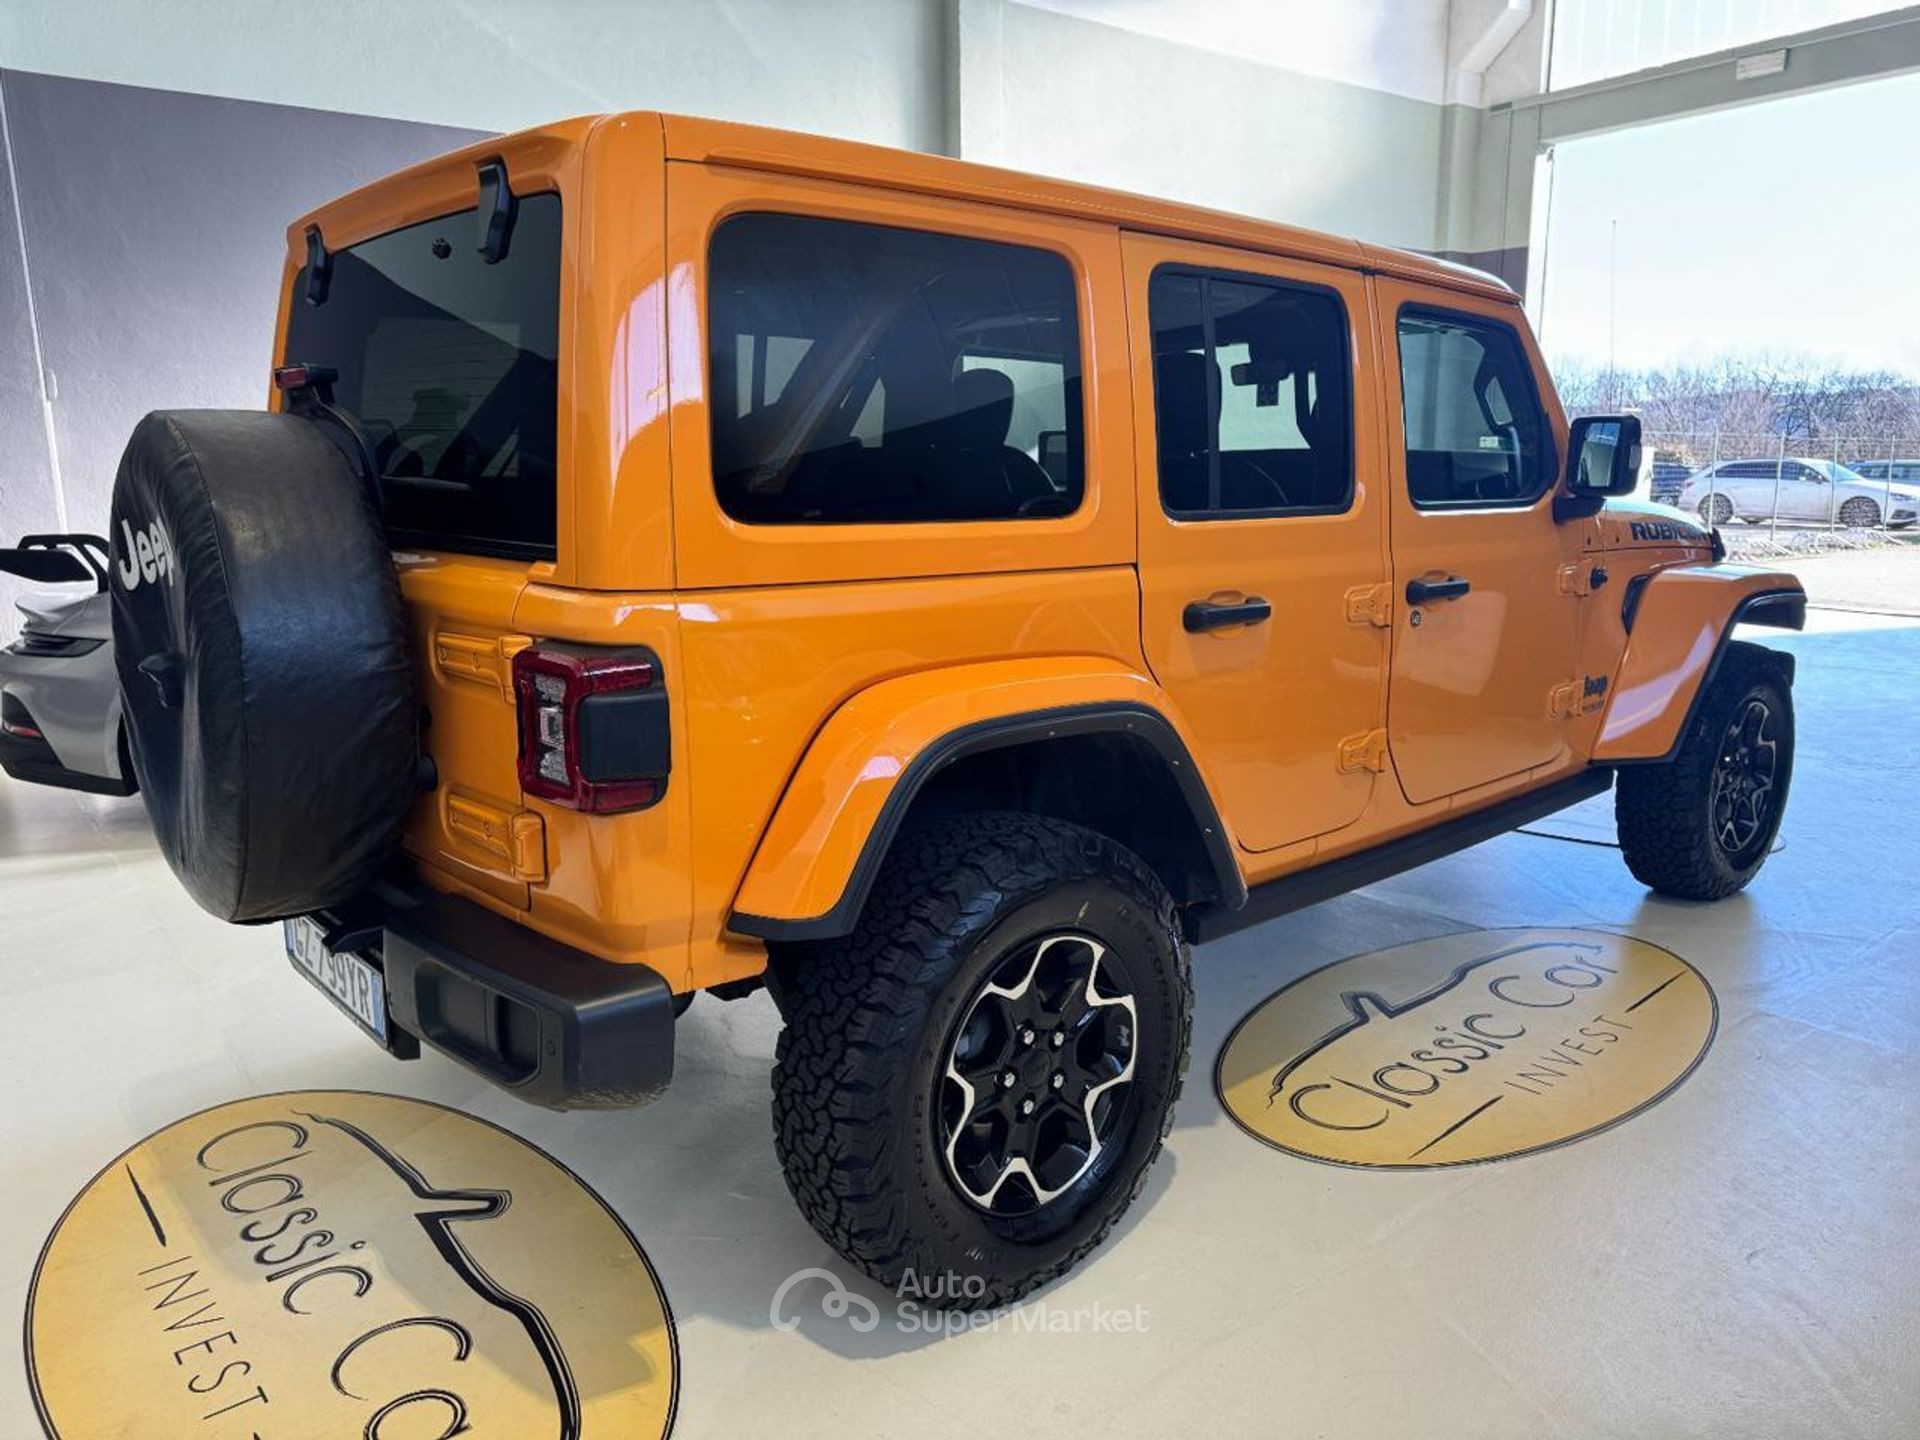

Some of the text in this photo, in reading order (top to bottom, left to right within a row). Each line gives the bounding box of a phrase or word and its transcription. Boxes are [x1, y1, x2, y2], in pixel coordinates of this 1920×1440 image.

[119, 516, 174, 591] Jeep
[1289, 952, 1619, 1131] Classic Car
[1503, 1014, 1633, 1096] INVEST
[196, 1119, 373, 1315] Classic
[138, 1255, 269, 1421] INVEST
